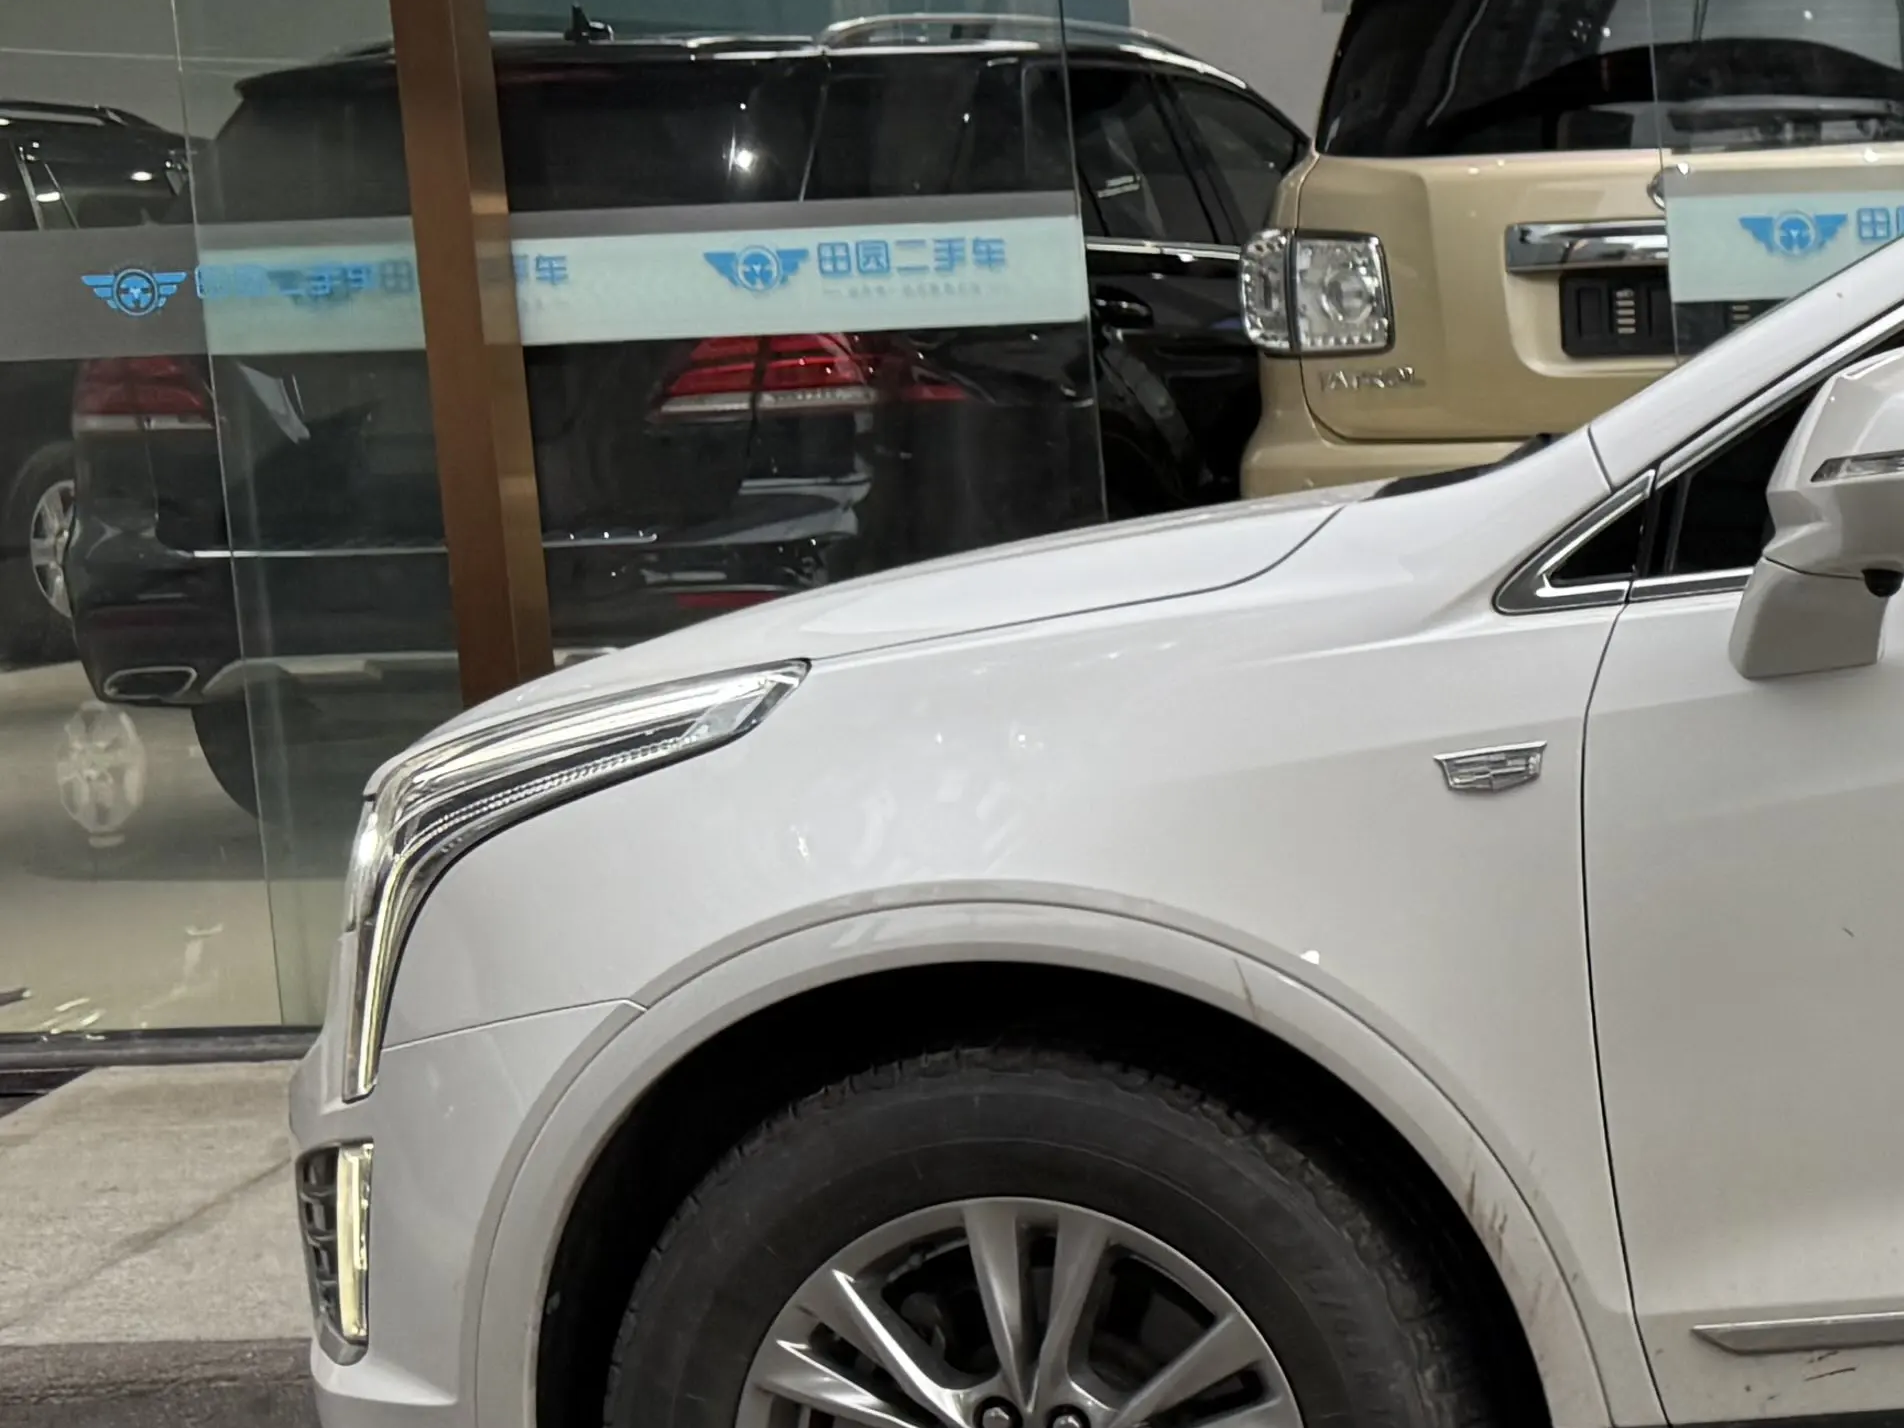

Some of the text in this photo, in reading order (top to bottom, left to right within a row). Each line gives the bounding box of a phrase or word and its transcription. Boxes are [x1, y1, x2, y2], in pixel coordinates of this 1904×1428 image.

[817, 236, 1008, 276] 田园二手车
